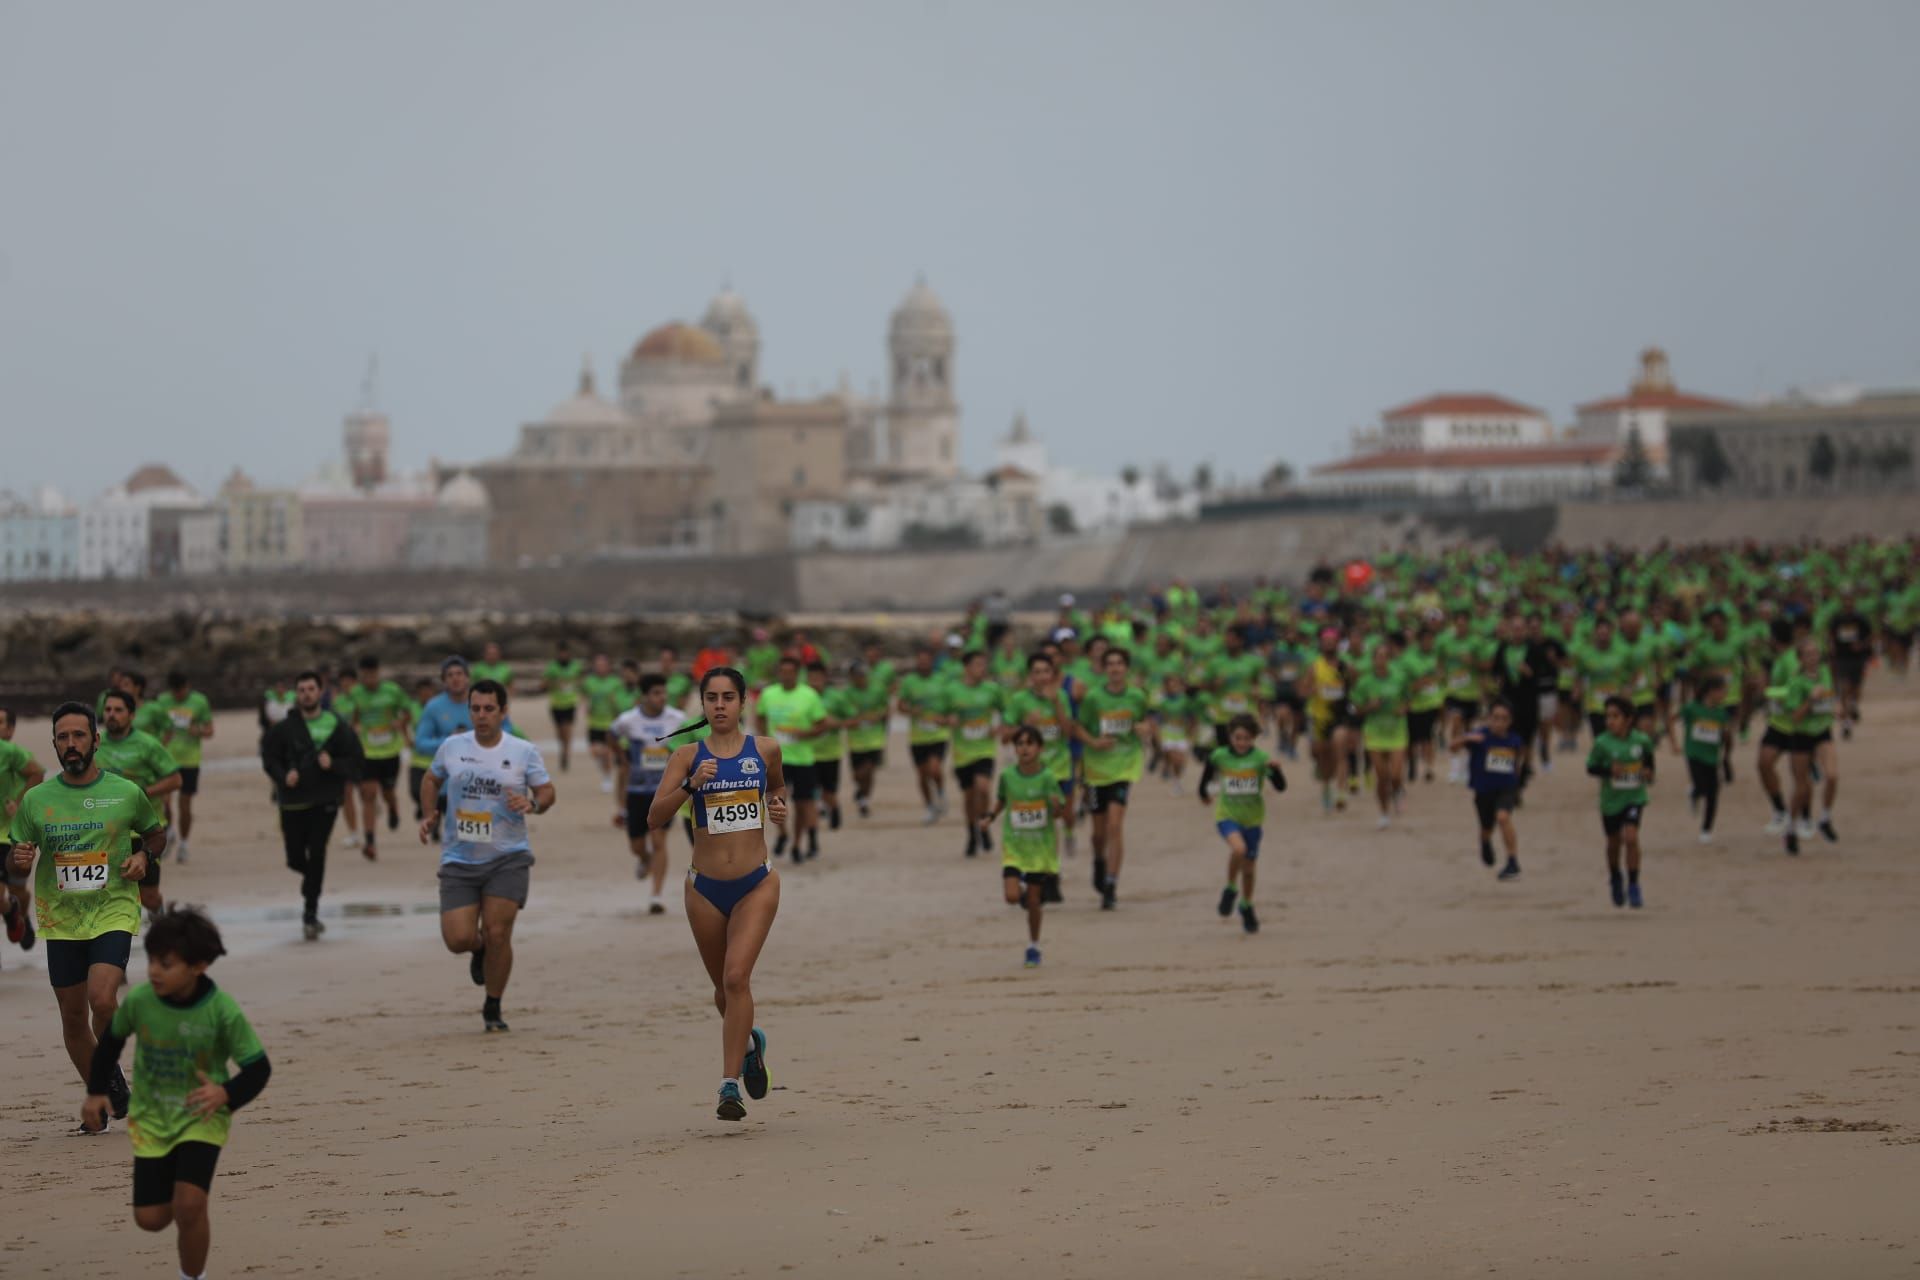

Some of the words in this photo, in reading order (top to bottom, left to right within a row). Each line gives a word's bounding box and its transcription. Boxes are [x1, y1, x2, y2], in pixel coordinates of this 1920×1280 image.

[697, 777, 760, 791] irabuzón
[714, 803, 757, 823] 4599
[45, 823, 57, 832] En
[61, 820, 103, 831] marcha
[458, 819, 490, 835] 4511
[46, 832, 80, 843] contra
[61, 865, 105, 882] 1142
